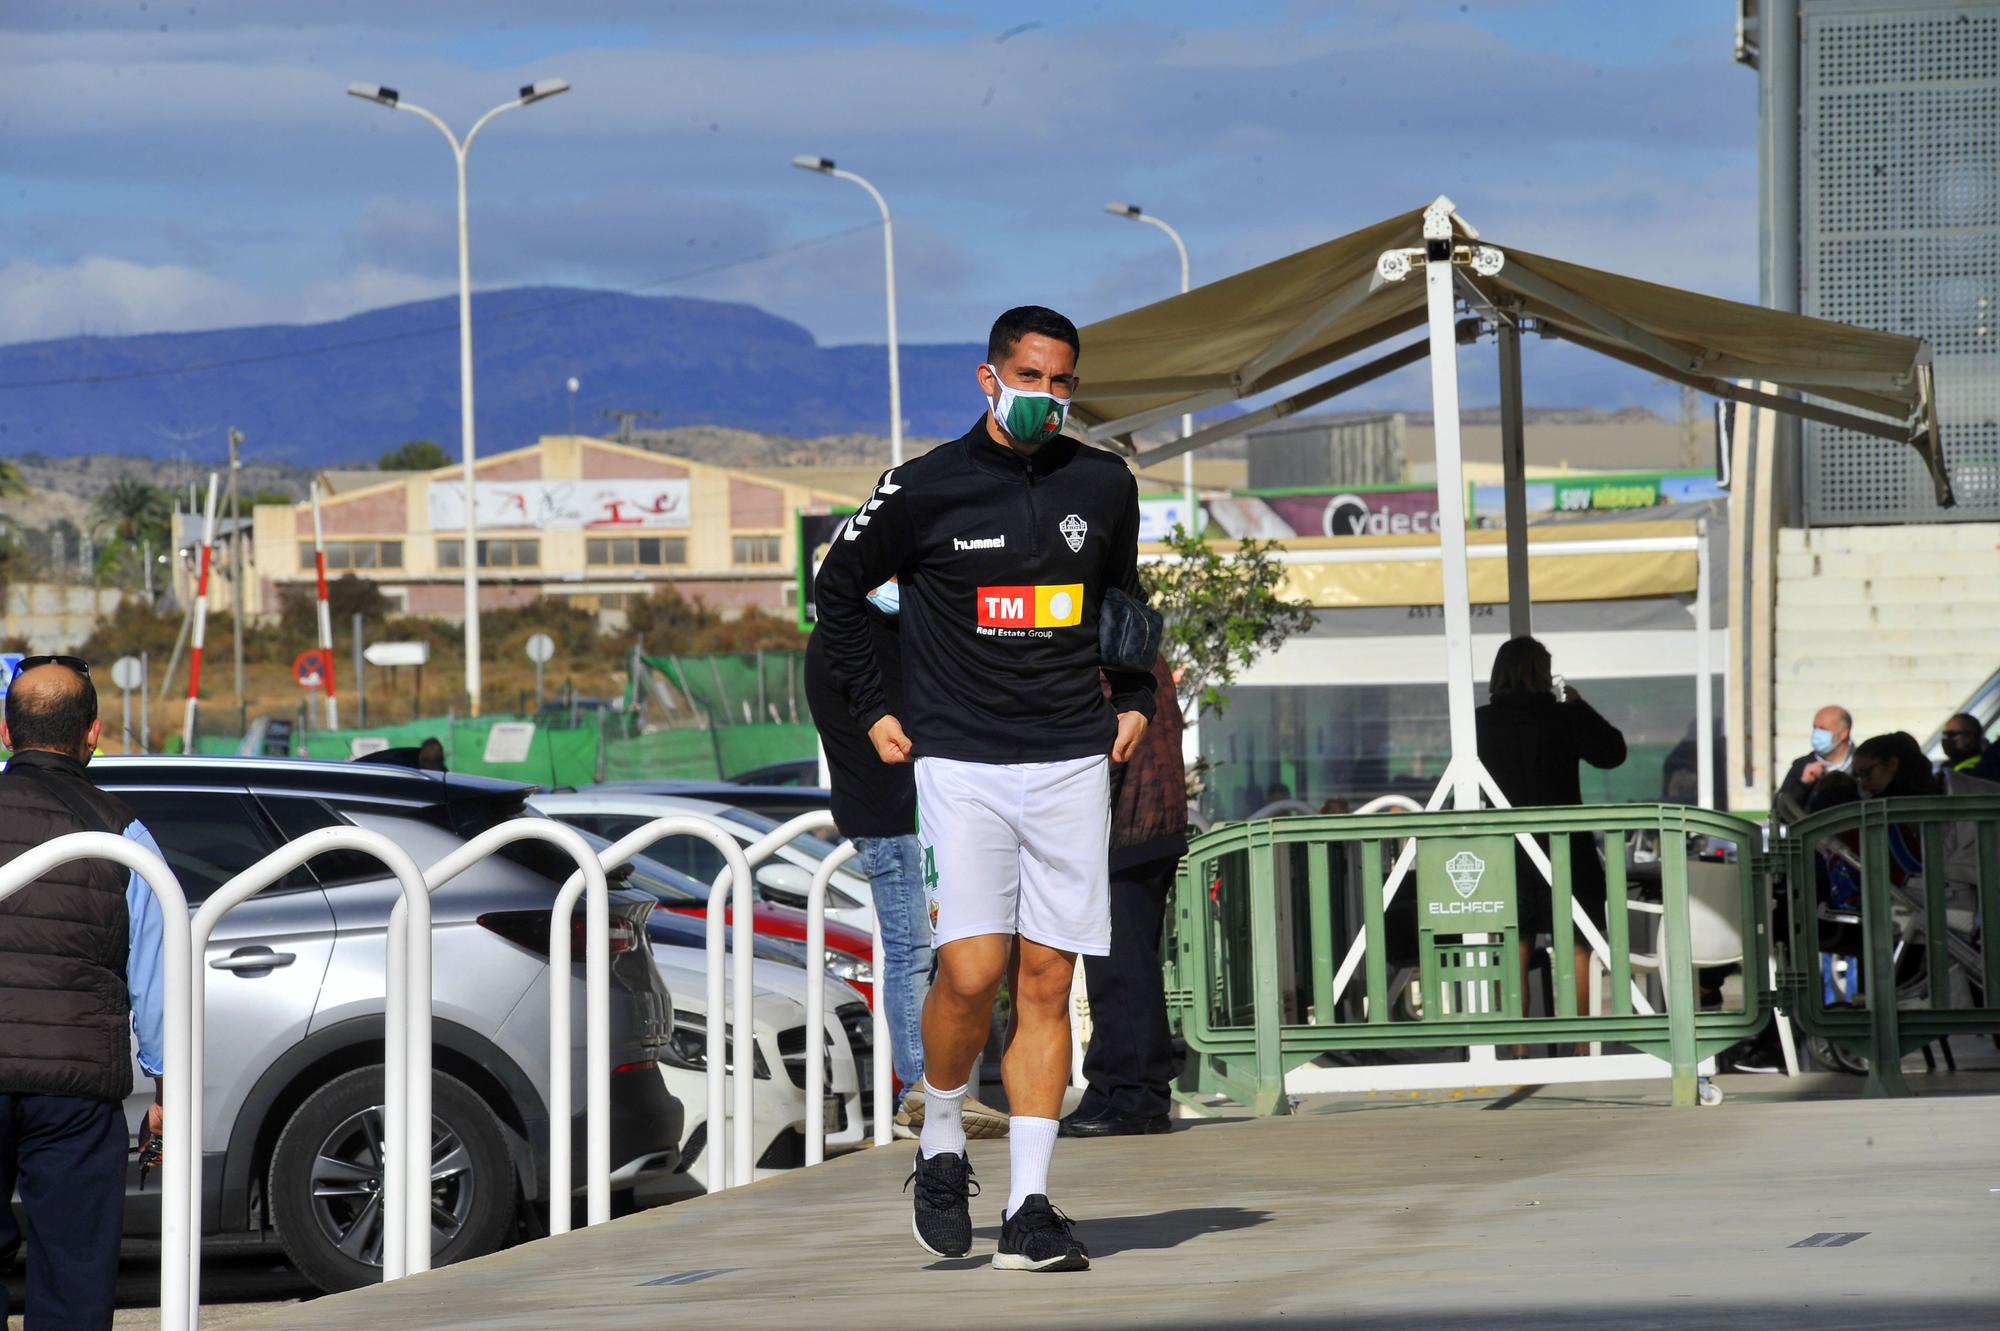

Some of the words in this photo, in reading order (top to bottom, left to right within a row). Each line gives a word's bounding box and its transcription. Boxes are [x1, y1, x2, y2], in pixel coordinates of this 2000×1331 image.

[953, 534, 1005, 551] hummel
[984, 597, 1024, 619] TM
[976, 626, 996, 636] Real
[998, 629, 1026, 637] Estate
[1027, 630, 1053, 639] Group
